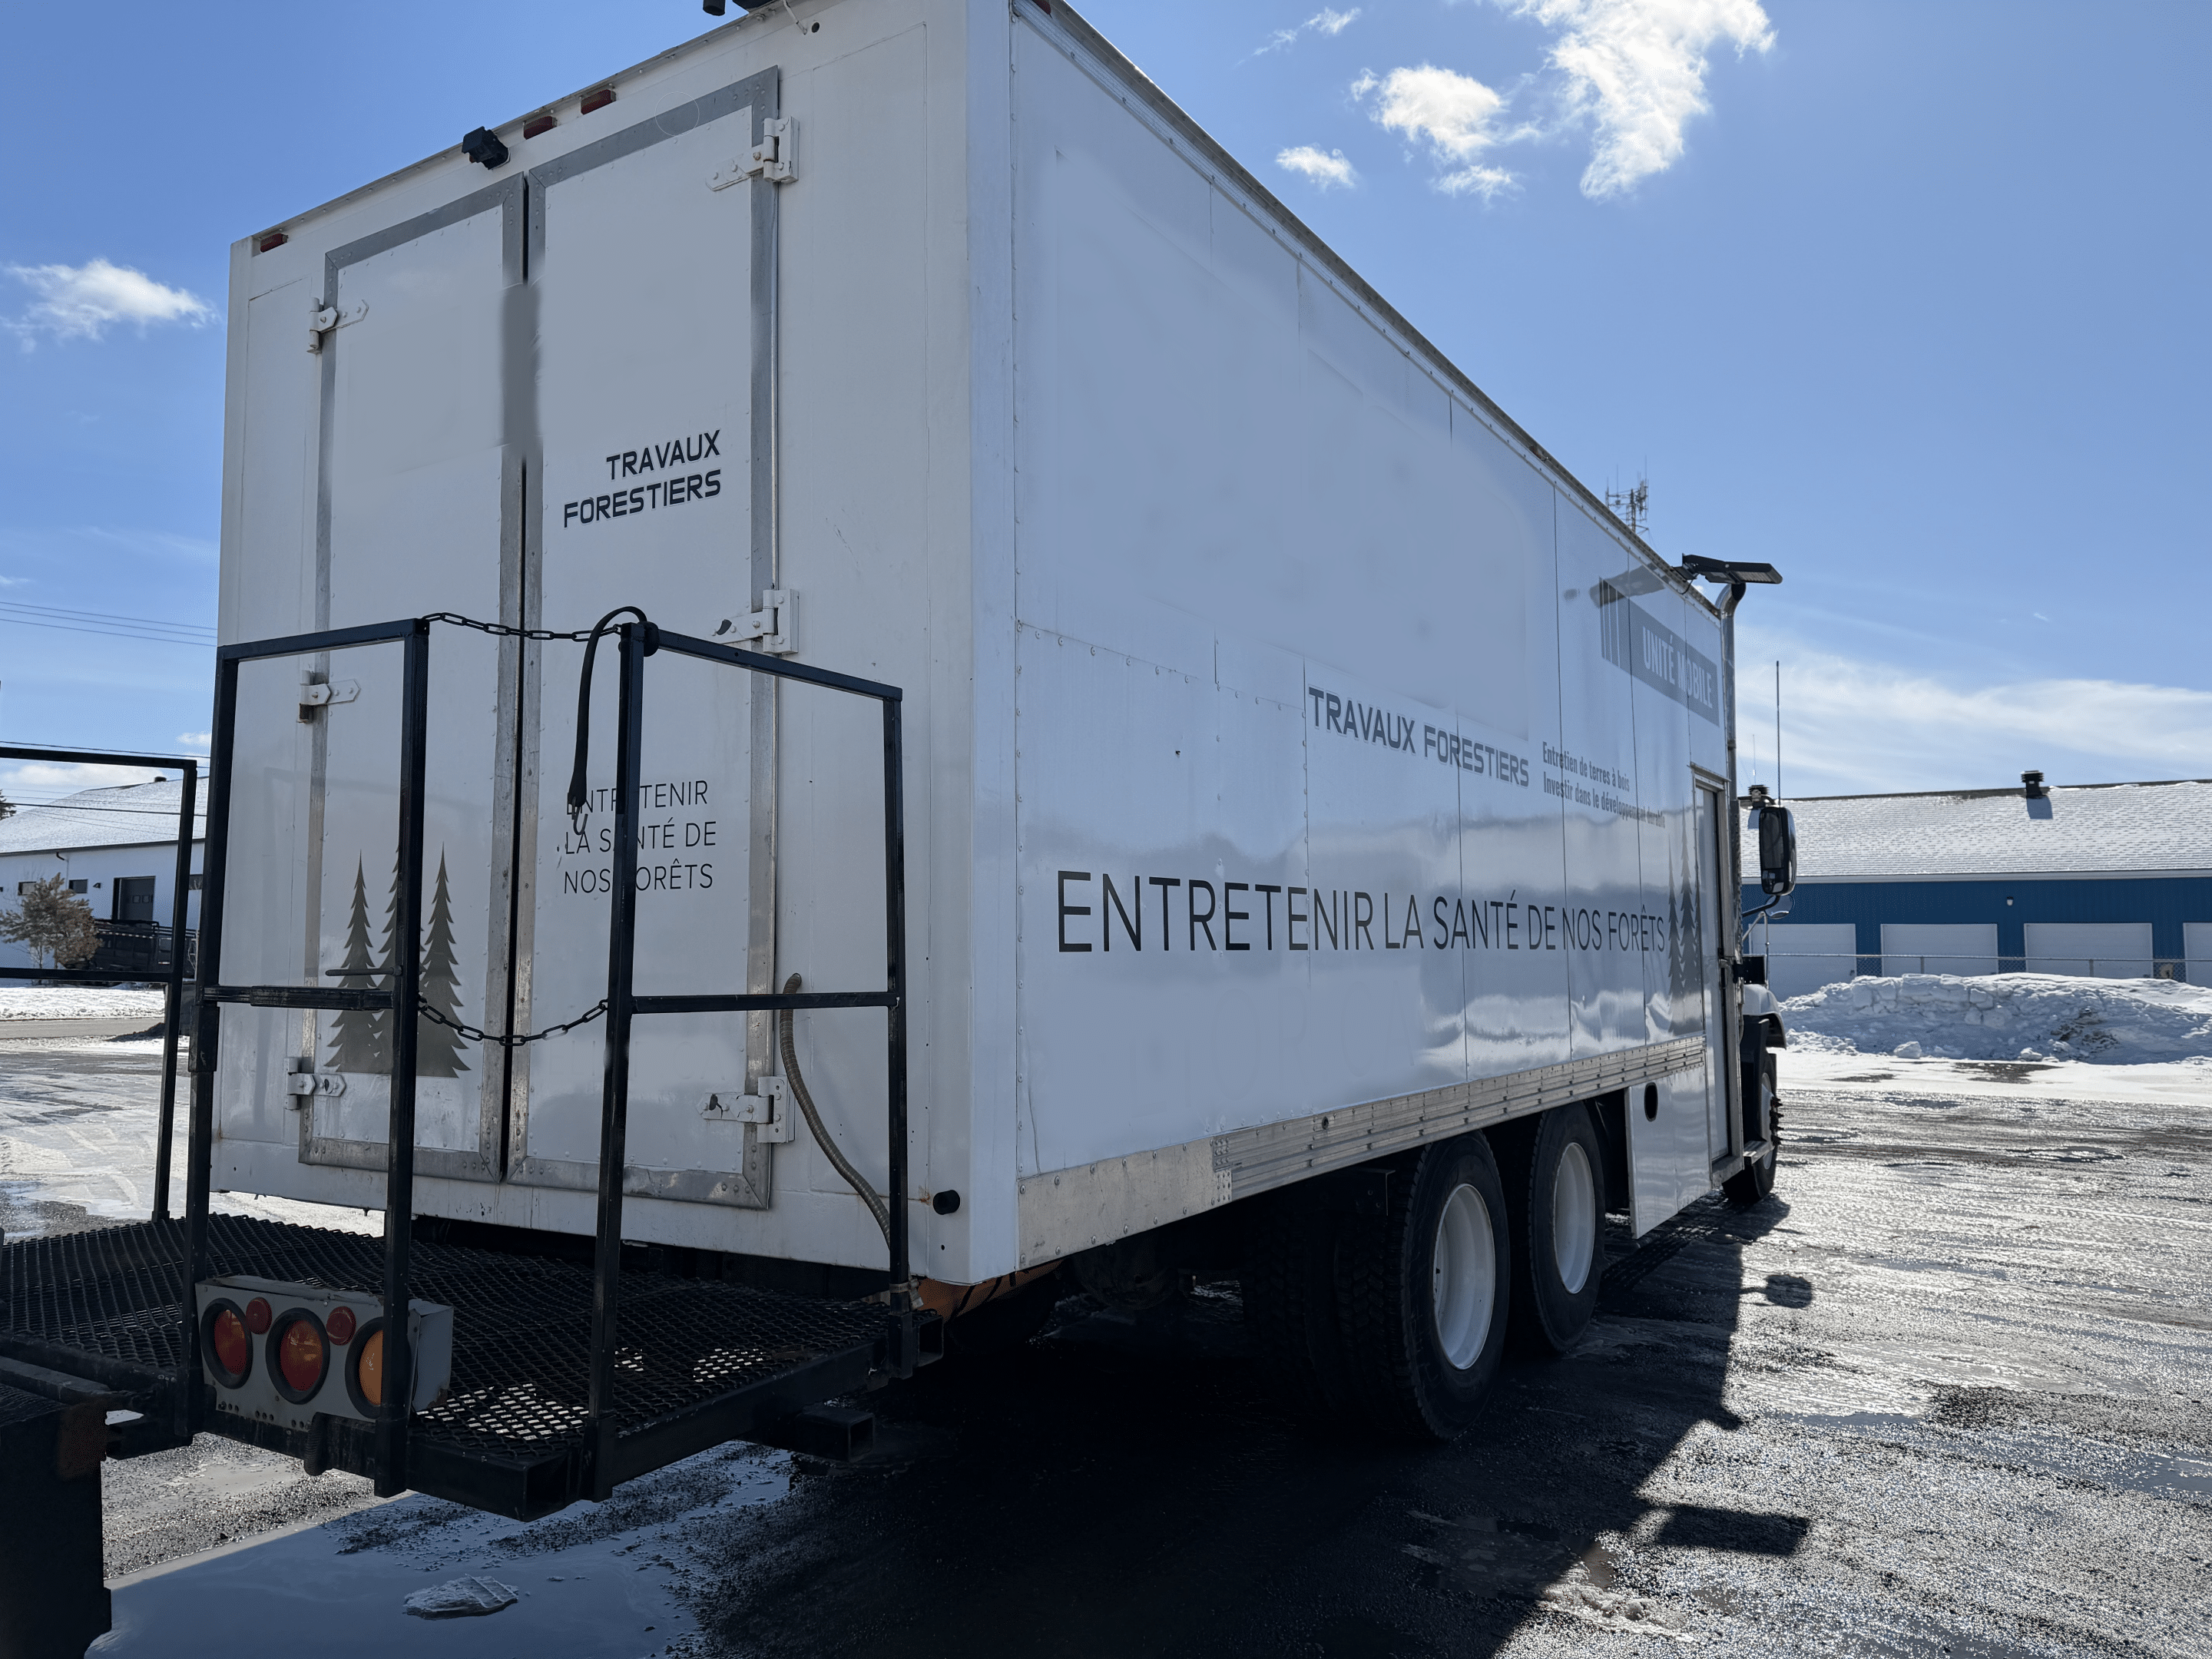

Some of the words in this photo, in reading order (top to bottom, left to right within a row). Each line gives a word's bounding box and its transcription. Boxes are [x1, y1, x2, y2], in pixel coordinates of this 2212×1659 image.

[606, 429, 720, 480] TRAVAUX
[564, 469, 721, 528] FORESTIERS
[1643, 626, 1675, 685] UNITÉ
[1677, 651, 1713, 709] MOBILE
[1309, 686, 1416, 754] TRAVAUX
[1424, 724, 1529, 787] FORESTIERS
[1542, 740, 1578, 774] Entretien
[1579, 756, 1588, 777] de
[1589, 760, 1611, 786] terres
[1611, 767, 1617, 787] à
[1618, 770, 1630, 792] bois
[1543, 771, 1574, 800] Investir
[1575, 783, 1591, 806] dans
[1592, 788, 1600, 809] le
[565, 830, 591, 854] LA
[685, 821, 717, 847] DE
[564, 869, 611, 894] NOS
[635, 858, 714, 891] ORÊTS
[1058, 870, 1374, 952] ENTRETENIR
[1385, 892, 1425, 949] LA
[1433, 889, 1519, 950] SANTÉ
[1528, 905, 1556, 951] DE
[1562, 907, 1603, 952] NOS
[1608, 904, 1665, 952] FORÊTS
